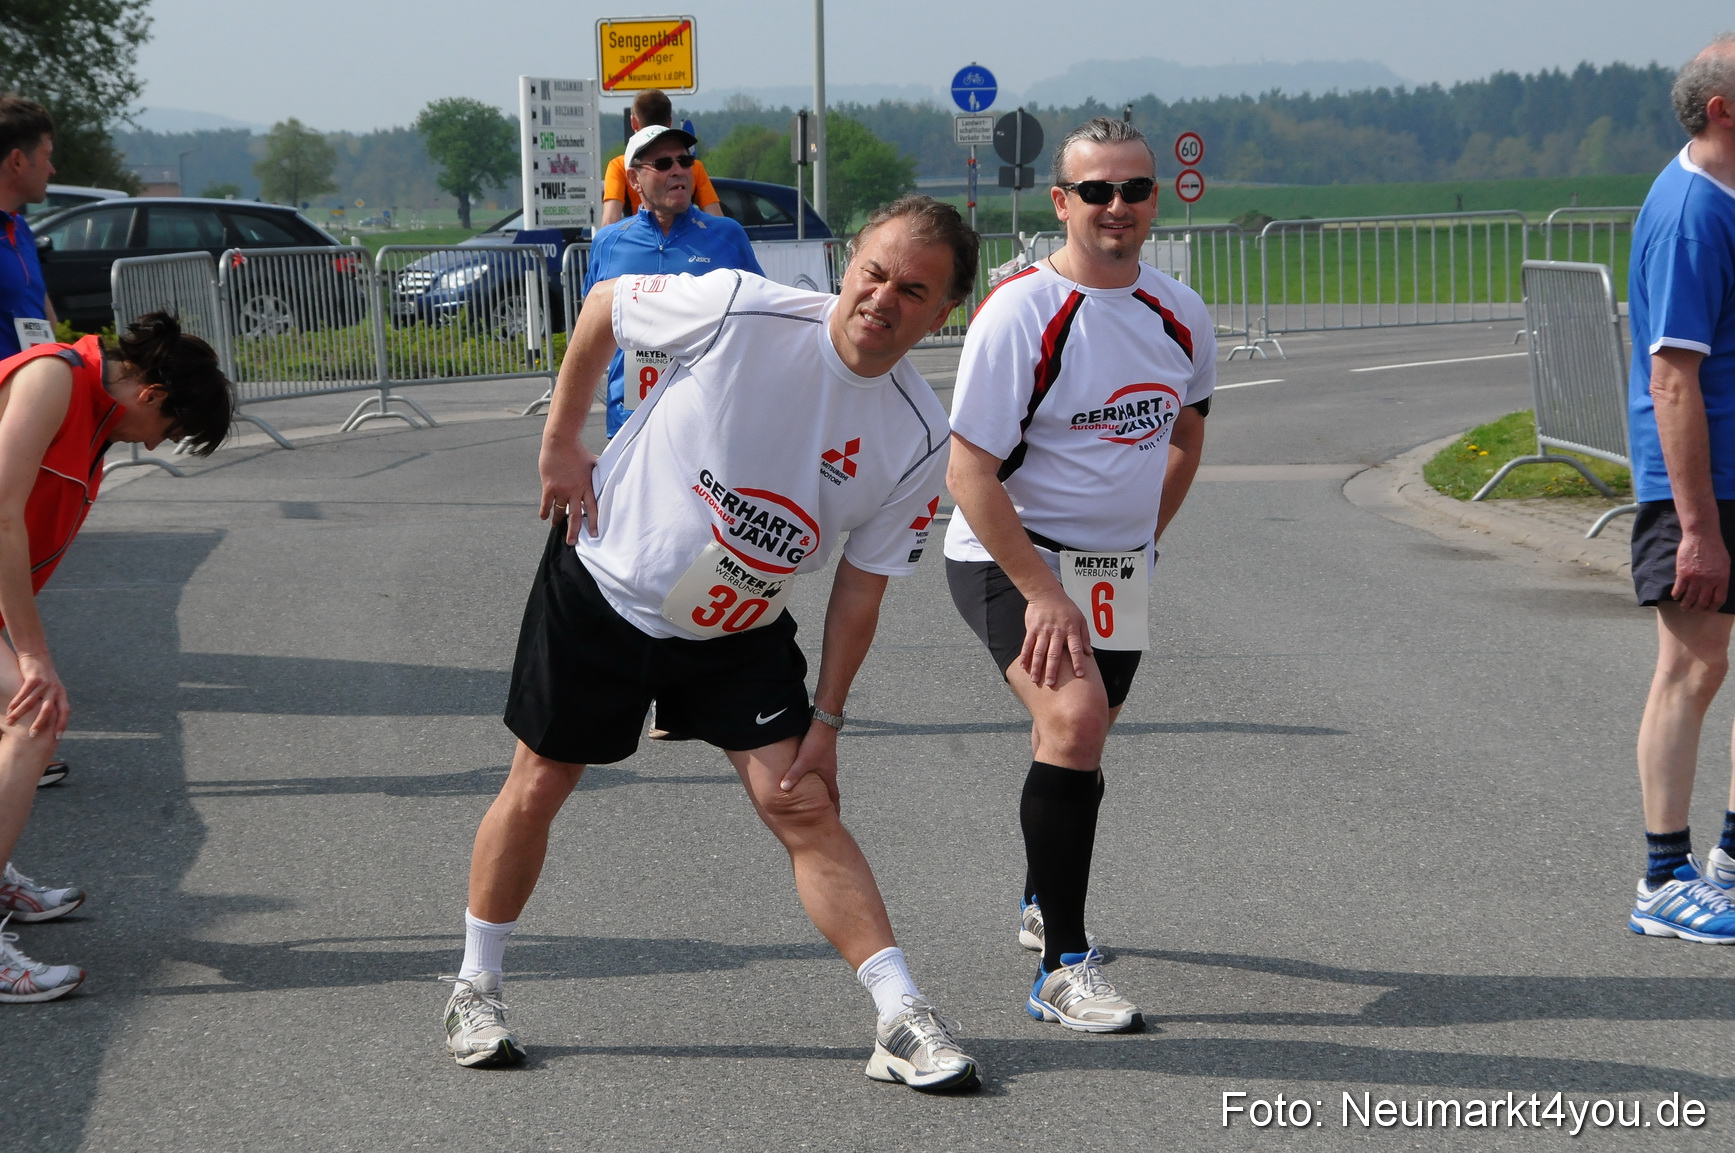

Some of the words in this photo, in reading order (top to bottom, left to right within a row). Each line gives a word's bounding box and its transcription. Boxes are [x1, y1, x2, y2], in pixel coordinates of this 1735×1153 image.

[609, 30, 684, 52] Sengenthal
[641, 52, 674, 65] Anger
[628, 71, 661, 81] Neumarkt
[540, 132, 555, 150] SHB
[1181, 141, 1198, 157] 60
[541, 182, 566, 200] THULE
[636, 350, 668, 358] MEYER
[1071, 397, 1163, 425] GERHART
[1069, 423, 1120, 431] Autohaus
[819, 468, 842, 487] MOTORS
[821, 460, 849, 482] MITSUBISHI
[691, 484, 736, 526] AUTOHAUS
[699, 469, 804, 543] GERHART
[799, 535, 810, 547] &
[728, 521, 805, 565] JÄNIG
[718, 556, 768, 589] MEYER
[1074, 556, 1118, 569] MEYER
[715, 565, 762, 596] WERBUNG
[1074, 568, 1119, 578] WERBUNG
[691, 584, 770, 633] 30
[1091, 581, 1114, 638] 6
